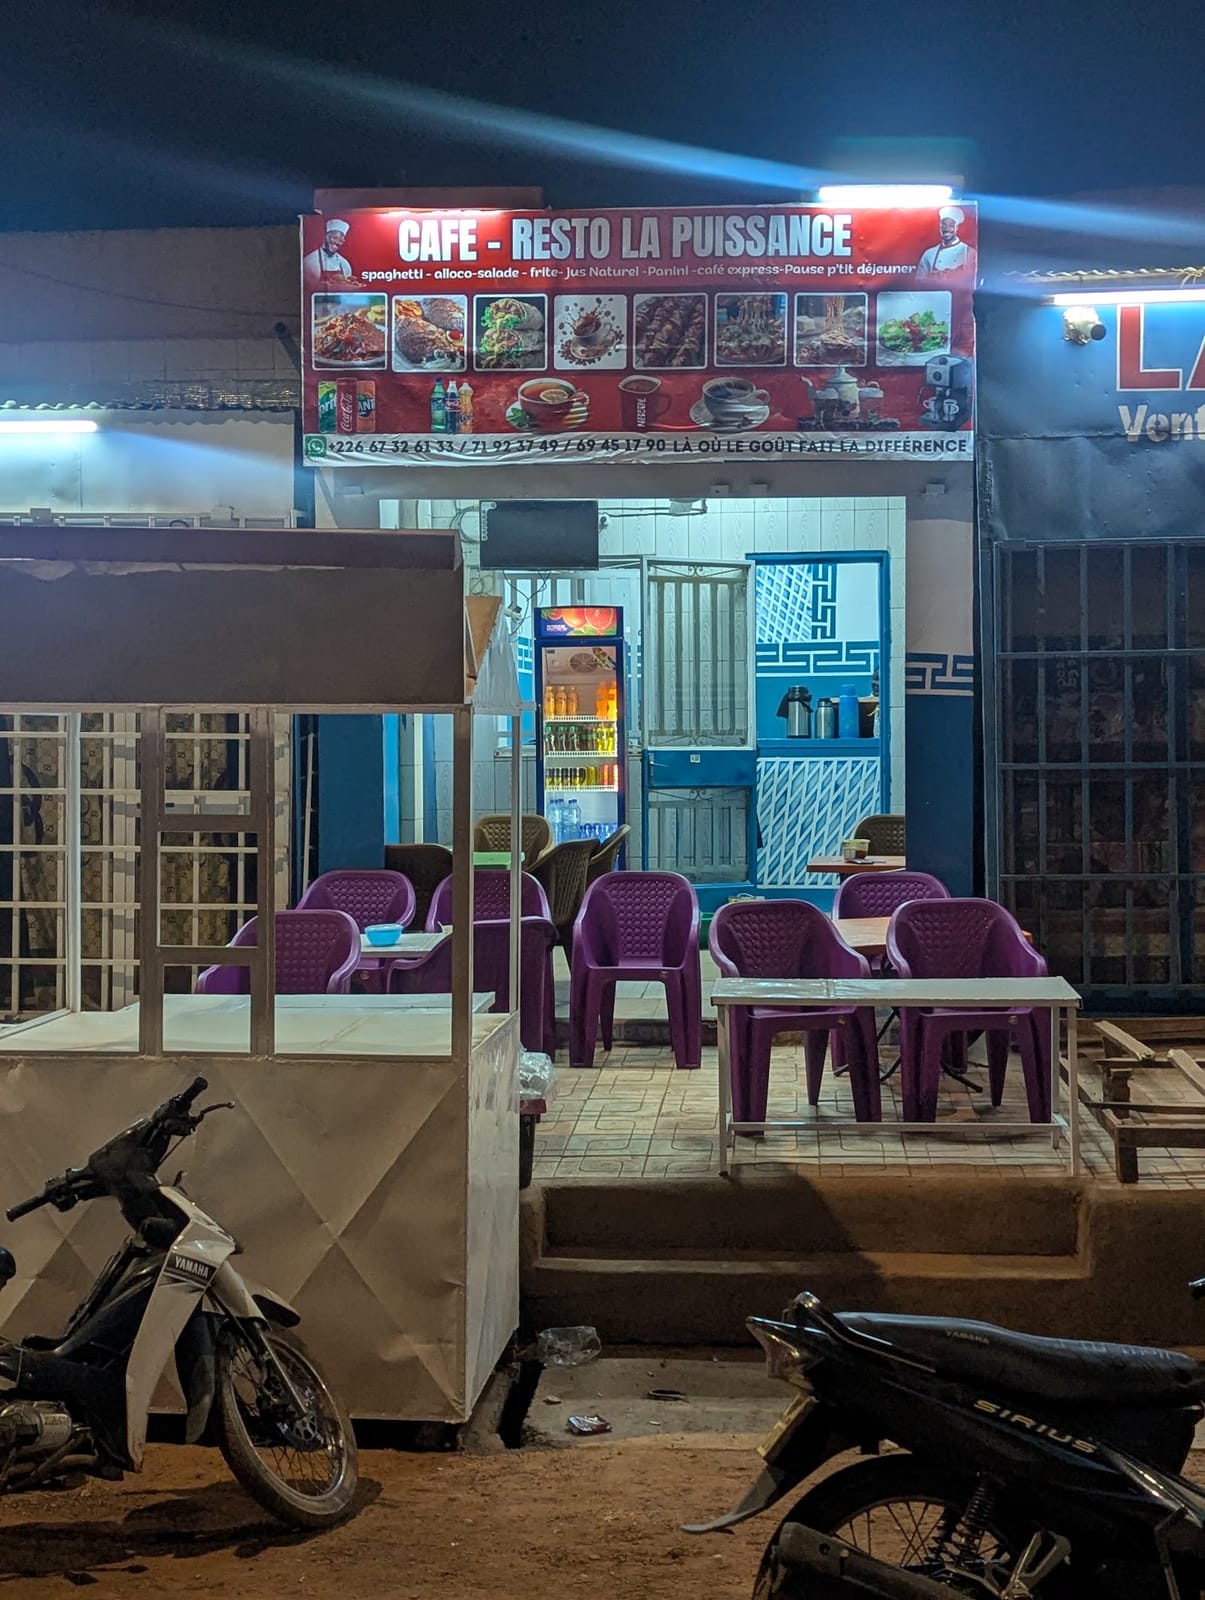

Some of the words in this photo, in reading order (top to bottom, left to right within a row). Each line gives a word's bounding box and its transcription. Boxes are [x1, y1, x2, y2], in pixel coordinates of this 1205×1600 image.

[398, 219, 477, 262] CAFE
[487, 241, 501, 249] -
[512, 217, 610, 260] RESTO
[621, 216, 661, 259] LA
[671, 214, 852, 258] PUISSANCE
[361, 268, 424, 282] spaghetti
[434, 267, 519, 280] alloco-salade
[589, 266, 639, 277] Naturel
[727, 264, 825, 278] express-Pause
[827, 263, 854, 277] p'tit
[857, 262, 916, 276] déjeuner
[1116, 302, 1205, 391] L
[329, 440, 363, 453] +226
[369, 440, 386, 453] 67
[391, 440, 409, 453] 32
[414, 440, 431, 453] 61
[436, 440, 454, 453] 33
[459, 441, 467, 453] /
[472, 440, 488, 453] 71
[493, 440, 510, 453] 92
[516, 440, 533, 452] 37
[539, 440, 558, 452] 49
[564, 440, 571, 451] /
[576, 439, 596, 451] 69
[601, 439, 619, 451] 45
[625, 439, 641, 451] 17
[646, 438, 665, 451] 90
[673, 437, 692, 452] LÀ
[698, 437, 721, 452] OÙ
[727, 440, 744, 452] LE
[749, 437, 794, 452] GOÛT
[800, 440, 833, 452] FAIT
[840, 440, 858, 452] LA
[865, 436, 967, 452] DIFFÉRENCE
[175, 1255, 209, 1279] YAMAHA
[973, 1400, 1098, 1454] SIRIUS
